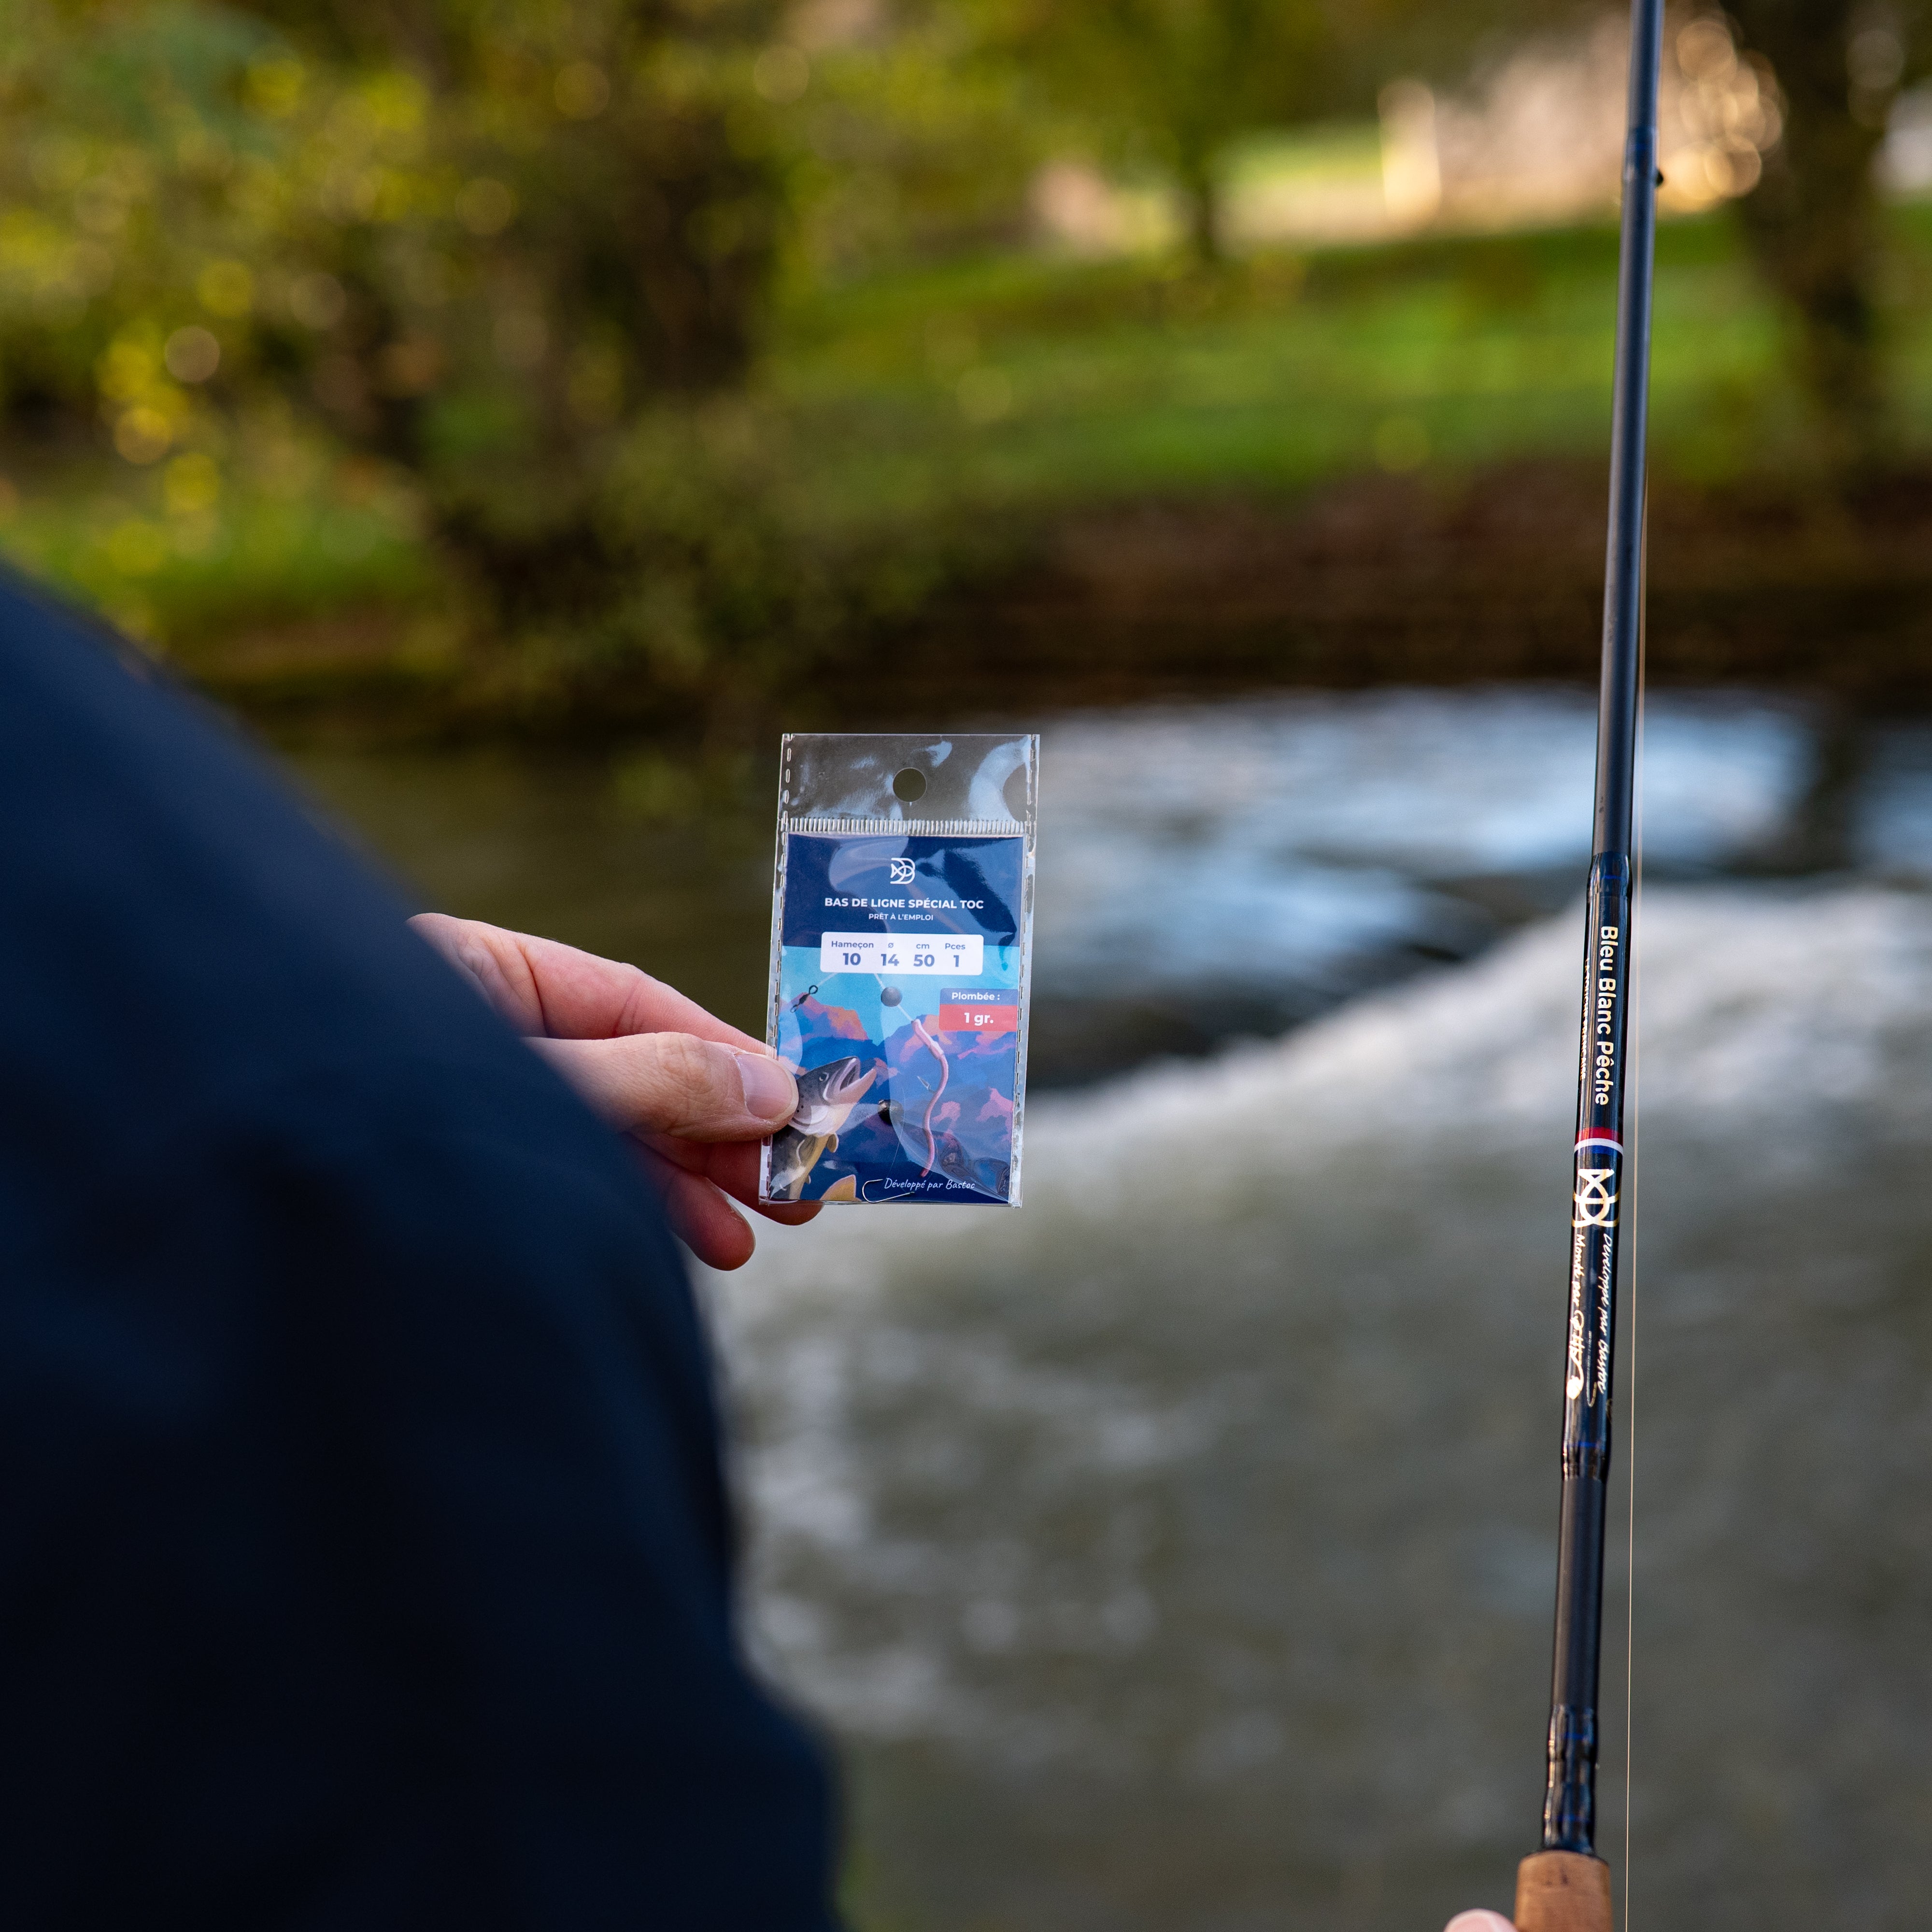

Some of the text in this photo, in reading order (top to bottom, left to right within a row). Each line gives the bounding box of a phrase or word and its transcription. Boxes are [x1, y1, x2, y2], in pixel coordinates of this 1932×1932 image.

[824, 897, 984, 909] BAS DE LIGNE SPÉCIAL TOC
[890, 912, 896, 920] À
[831, 940, 874, 950] Hameçon
[842, 952, 861, 966] 10
[881, 953, 900, 966] 14
[913, 954, 935, 967] 50
[953, 955, 960, 967] 1
[952, 992, 995, 1001] Plombée
[964, 1012, 994, 1026] 1 gr.
[1595, 925, 1619, 1106] Bleu Blanc Pêche
[884, 1178, 975, 1191] Développé par Bastoc
[1573, 1234, 1586, 1279] Monté
[1571, 1280, 1581, 1307] par
[1597, 1306, 1608, 1336] par
[1596, 1339, 1610, 1395] Bastoc
